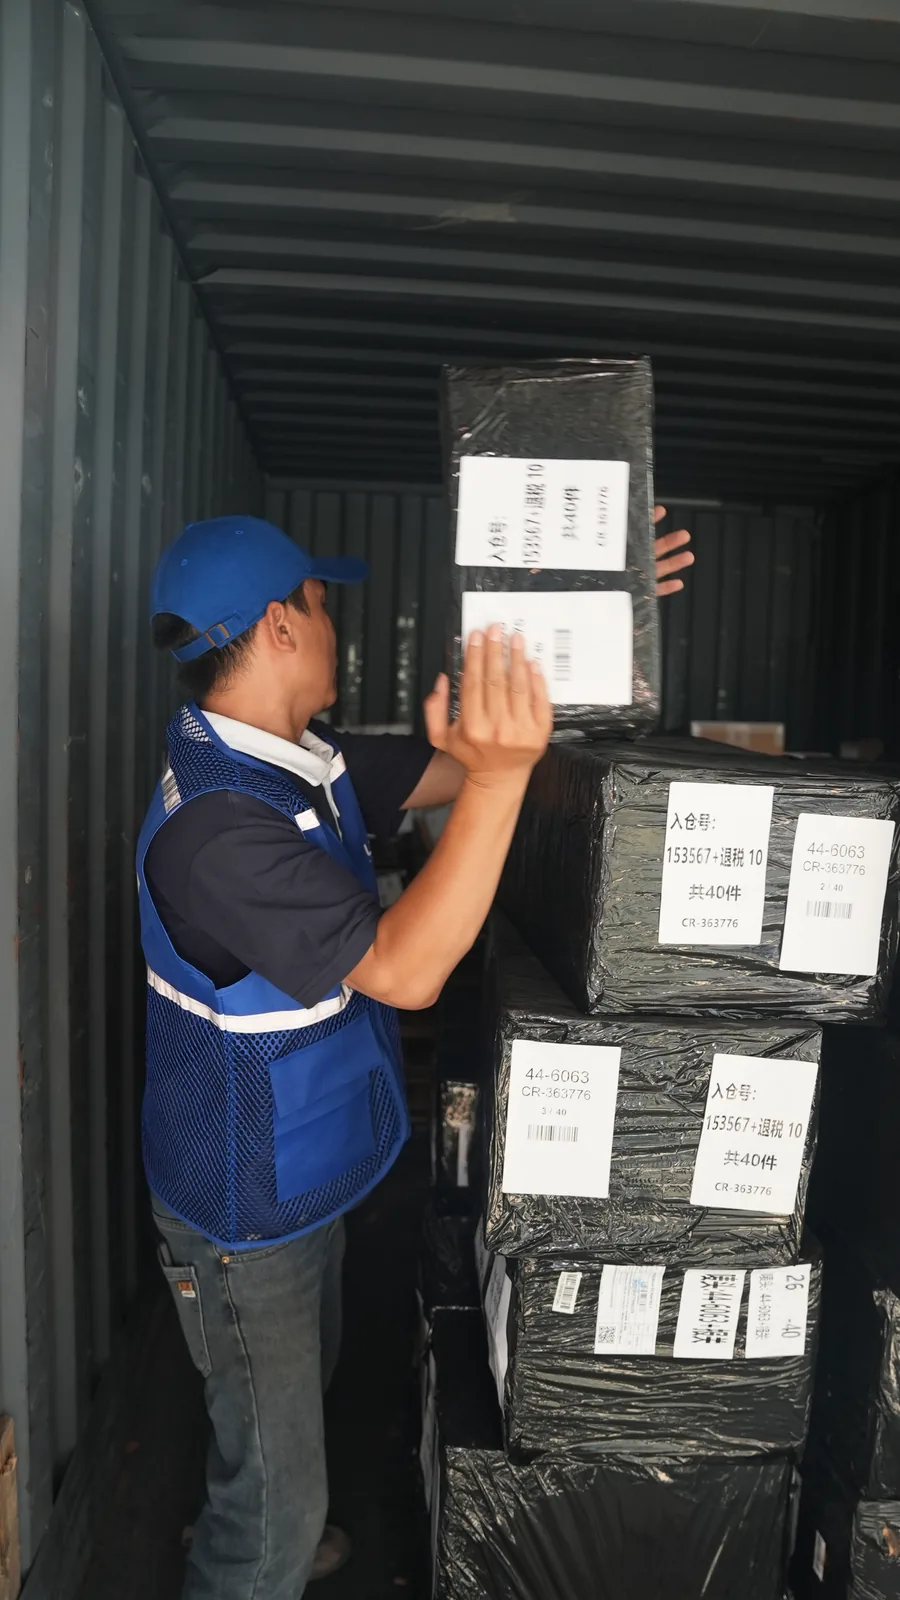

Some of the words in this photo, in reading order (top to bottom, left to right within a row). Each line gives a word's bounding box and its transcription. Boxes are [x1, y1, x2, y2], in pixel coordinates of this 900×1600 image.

[527, 463, 545, 478] 10
[670, 812, 716, 831] 入仓号:
[666, 846, 745, 868] 153567+退税
[749, 848, 763, 866] 10
[806, 841, 866, 859] 44-6063
[802, 860, 866, 876] CR-363776
[688, 883, 742, 901] 共40件
[681, 917, 739, 928] CR-363776
[525, 1067, 590, 1084] 44-6063
[521, 1085, 592, 1101] CR-363776
[711, 1082, 757, 1101] 入仓号:
[705, 1114, 784, 1139] 153567+退税
[788, 1122, 803, 1139] 10
[723, 1149, 778, 1171] 共40件
[714, 1181, 772, 1196] CR-363776
[785, 1274, 805, 1291] 26
